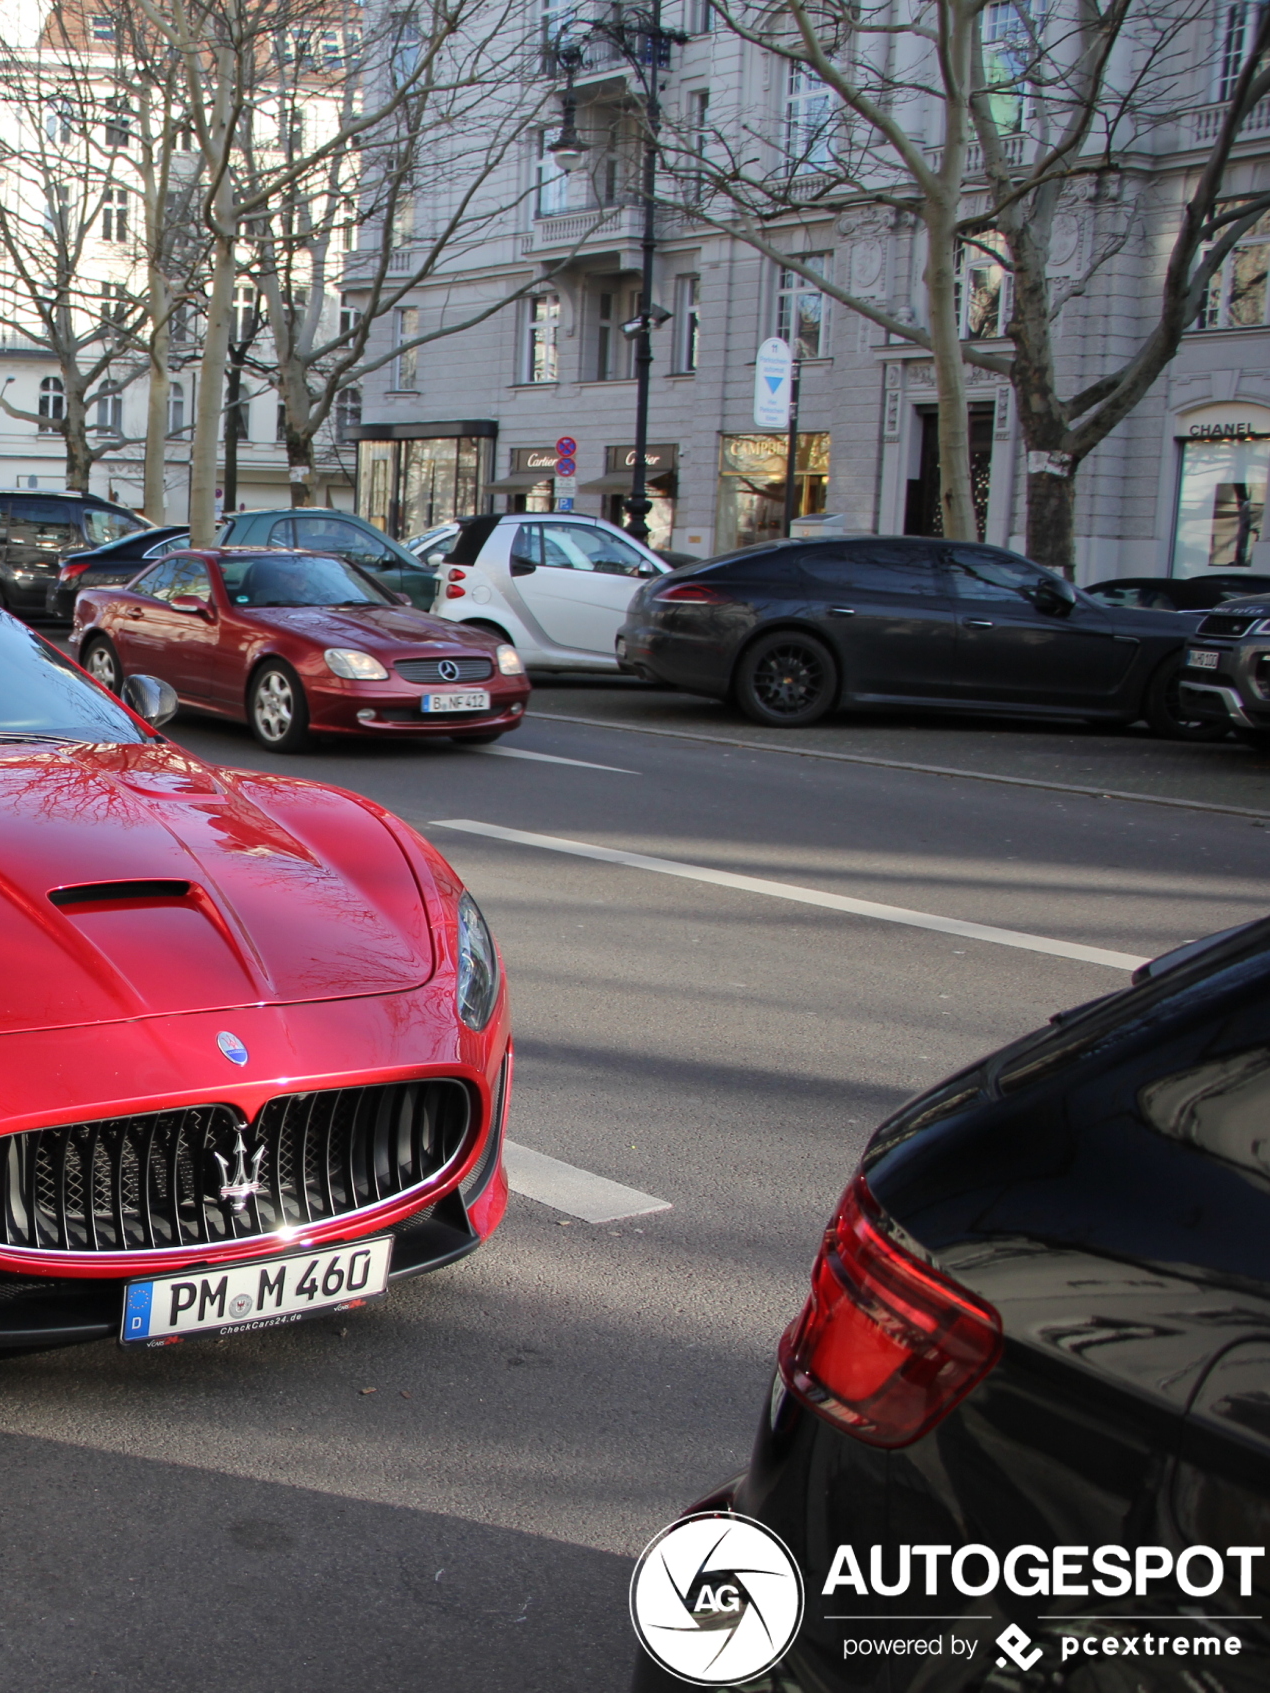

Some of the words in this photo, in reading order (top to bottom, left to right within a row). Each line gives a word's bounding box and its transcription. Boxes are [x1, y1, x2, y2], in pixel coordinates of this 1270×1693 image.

[1189, 422, 1255, 436] CHANEL
[527, 453, 559, 467] Cartier
[560, 499, 568, 508] P
[433, 697, 441, 710] B
[465, 695, 485, 708] 412
[169, 1275, 229, 1327] PM
[256, 1265, 287, 1311] M
[295, 1249, 371, 1301] 460
[132, 1316, 141, 1329] D
[219, 1313, 302, 1335] CheckCars24.de
